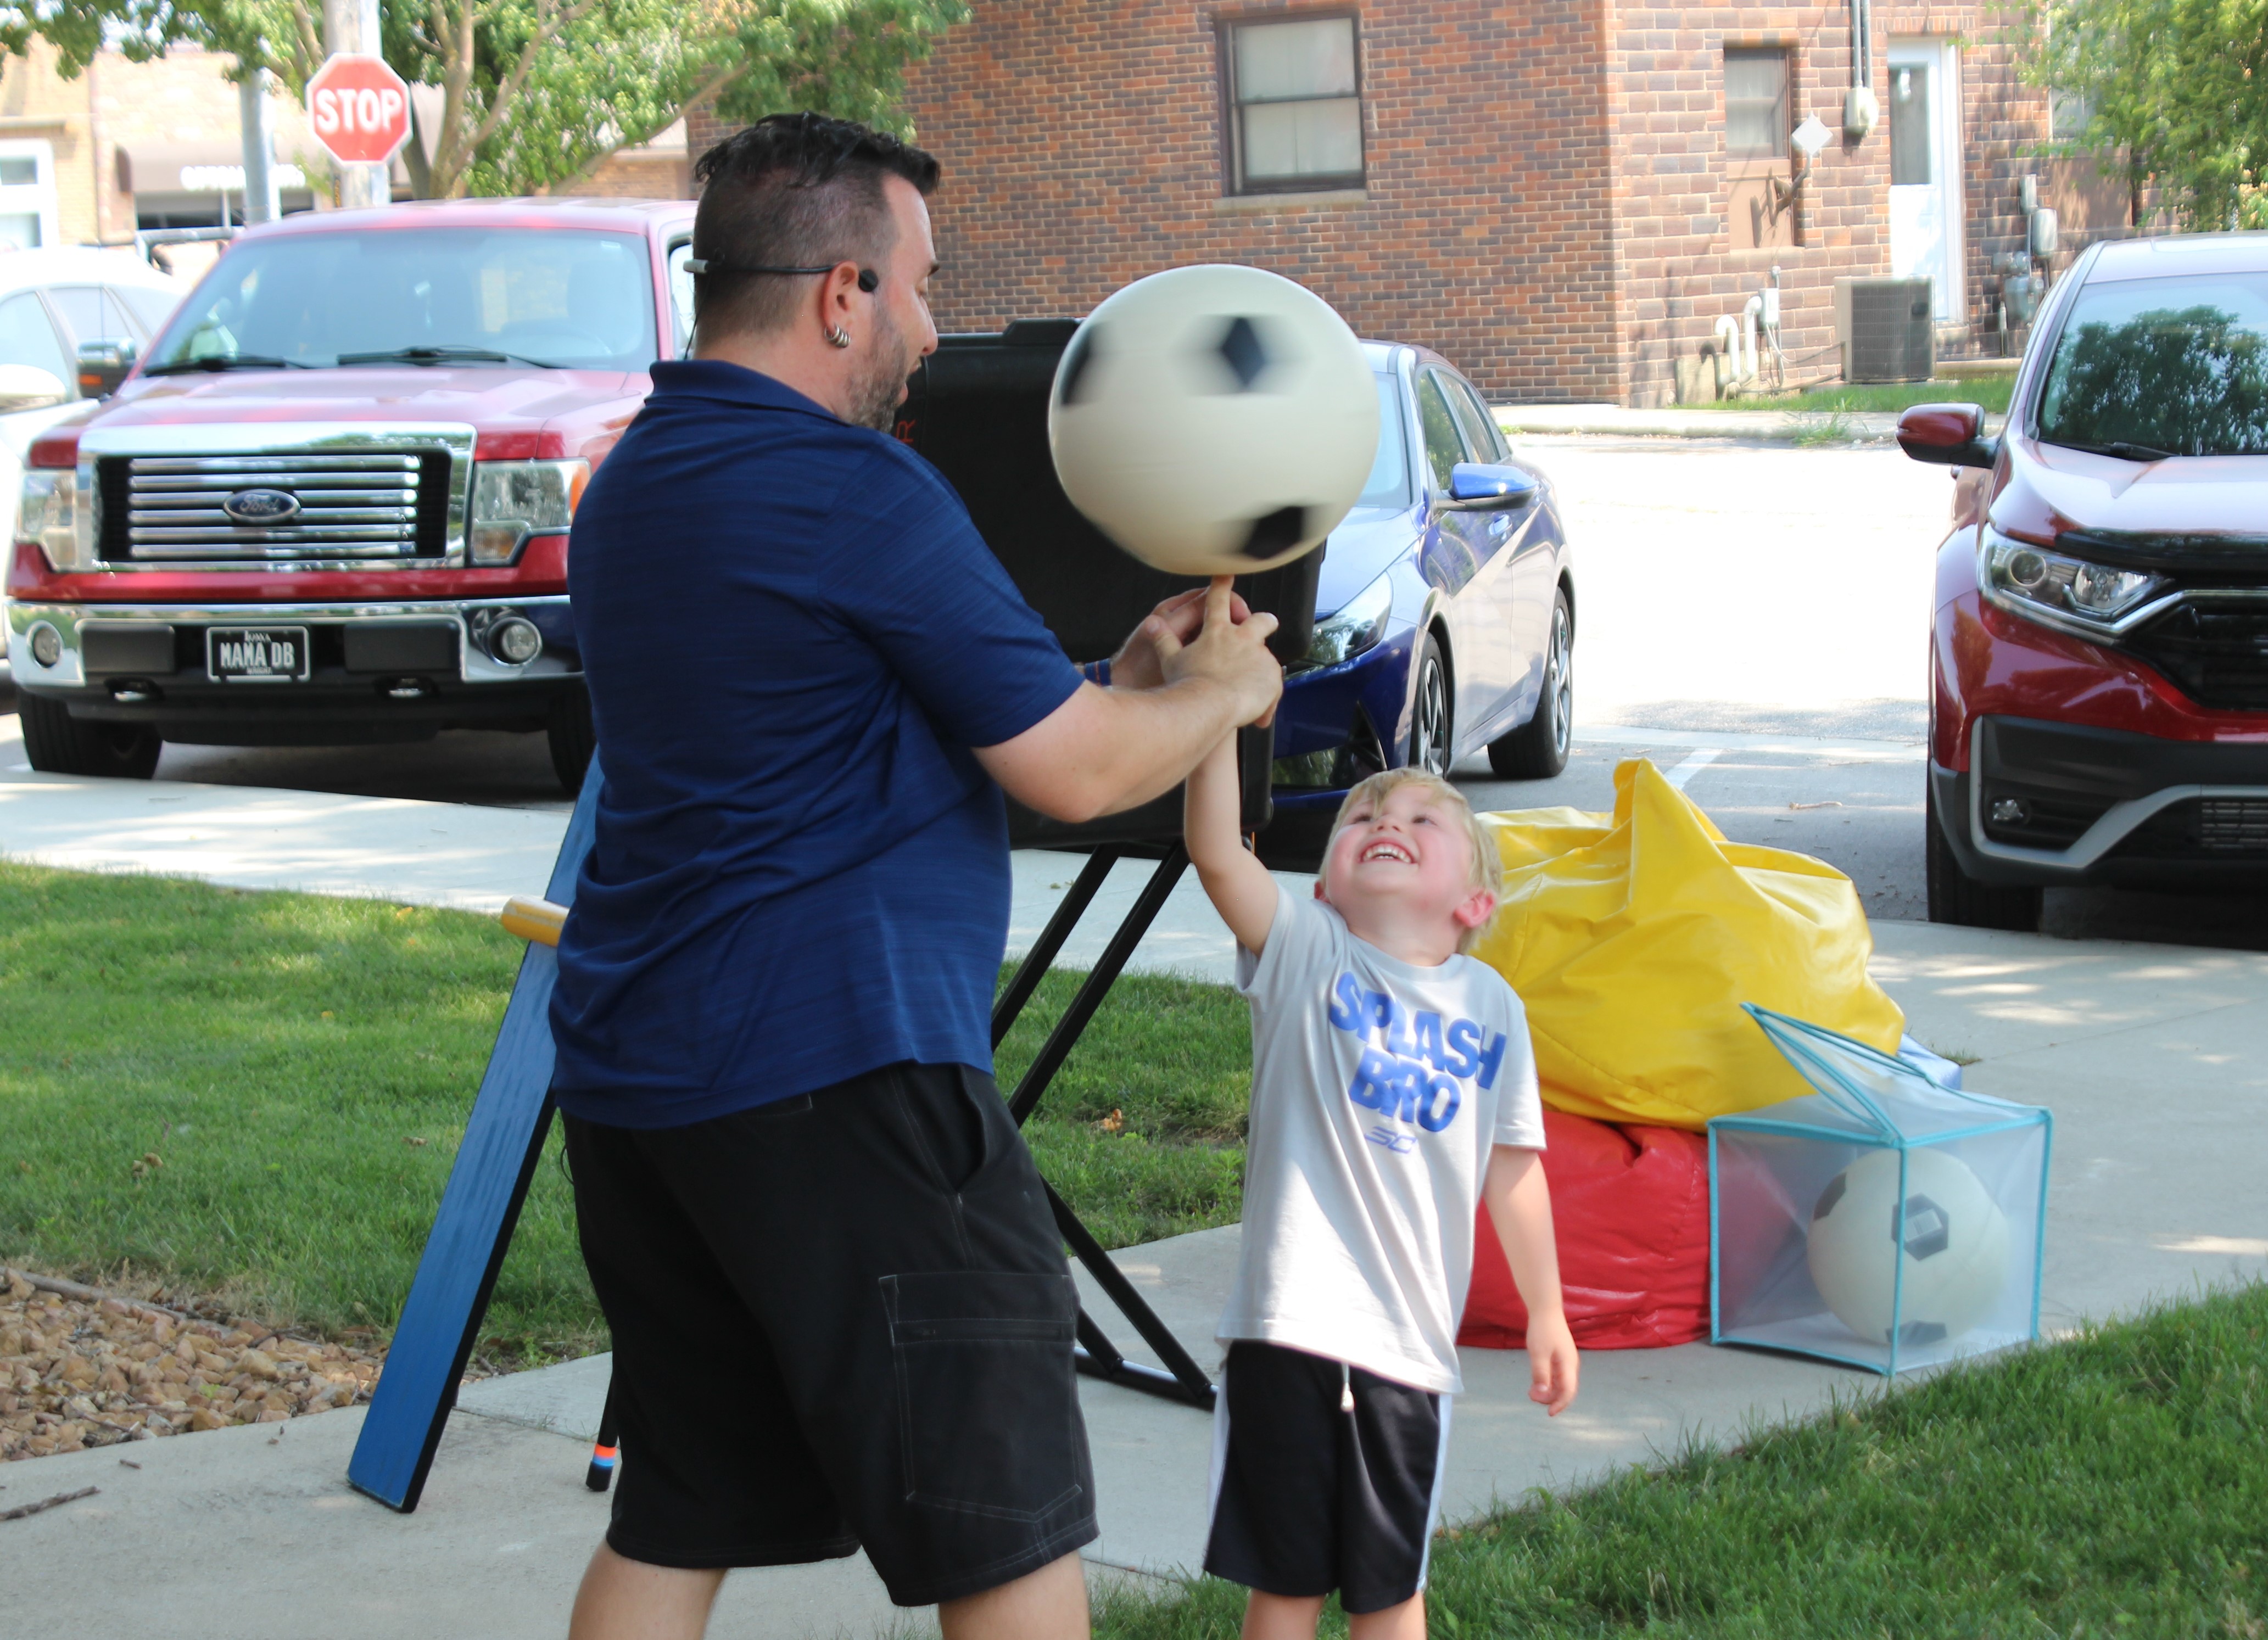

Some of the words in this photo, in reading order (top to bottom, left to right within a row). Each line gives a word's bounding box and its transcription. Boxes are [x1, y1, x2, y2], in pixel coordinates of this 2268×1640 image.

[316, 88, 403, 132] STOP
[239, 494, 281, 513] Ford
[271, 641, 295, 668] DB
[1329, 971, 1507, 1090] SPLASH
[1349, 1046, 1461, 1132] BRO
